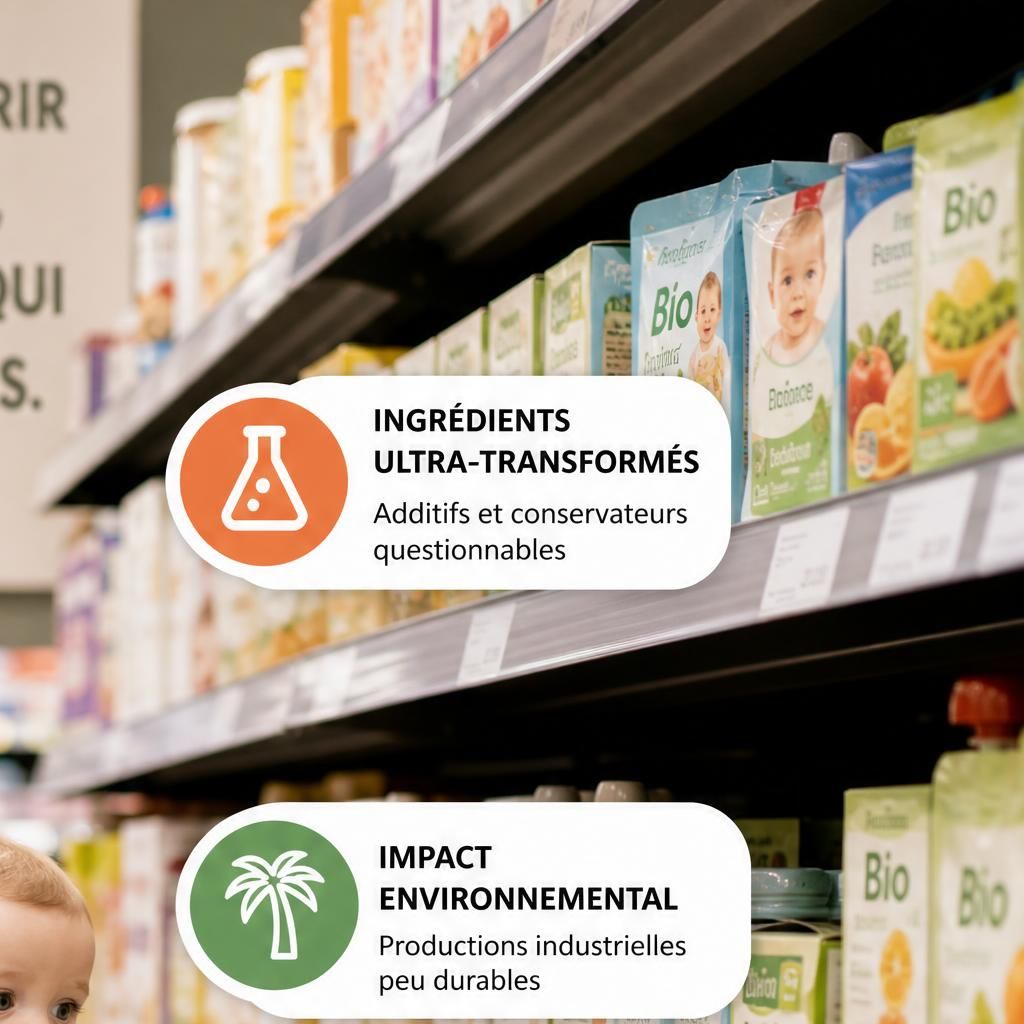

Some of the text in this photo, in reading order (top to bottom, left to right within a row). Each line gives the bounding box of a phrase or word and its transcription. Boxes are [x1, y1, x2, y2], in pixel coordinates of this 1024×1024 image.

[942, 181, 997, 235] Bio
[651, 282, 693, 337] Bio
[864, 852, 910, 902] Bio
[957, 867, 1010, 928] Bio
